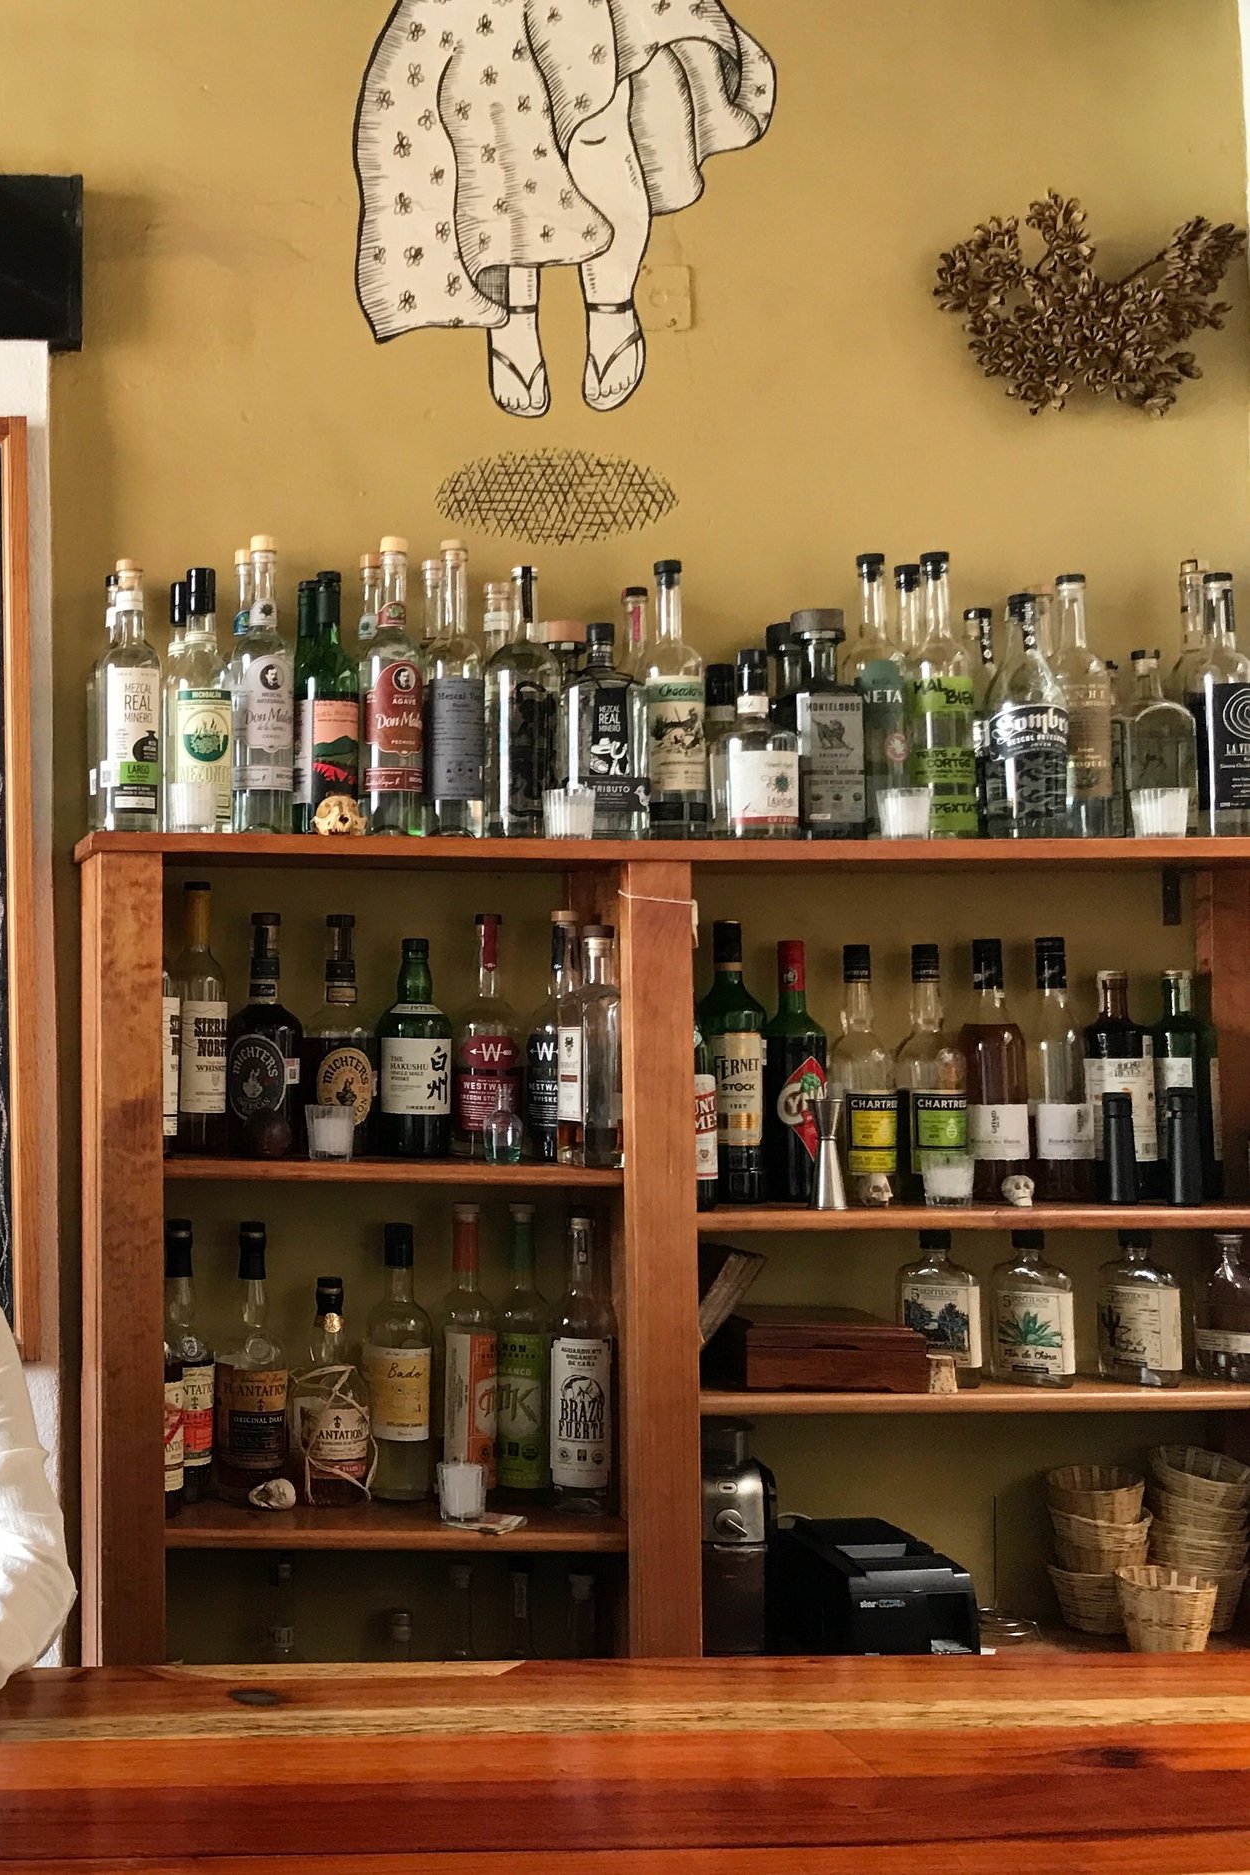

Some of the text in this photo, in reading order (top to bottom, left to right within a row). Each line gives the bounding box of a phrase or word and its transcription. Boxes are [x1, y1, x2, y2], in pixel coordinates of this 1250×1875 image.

[124, 683, 152, 694] MEZCAL
[124, 694, 153, 711] REAL
[392, 697, 417, 706] AGAVE
[862, 689, 903, 704] NETA
[598, 705, 620, 713] MEZCAL
[806, 702, 861, 712] MONTELOBOS
[124, 713, 153, 724] MINERO
[244, 709, 266, 725] Don
[375, 712, 400, 730] Don
[598, 713, 621, 725] REAL
[598, 724, 621, 733] MINERO
[127, 764, 150, 775] LARGO
[592, 785, 631, 793] TRIBUTO
[481, 1042, 501, 1062] W
[536, 1042, 555, 1061] W
[233, 1046, 278, 1078] MICHTER'S
[390, 1062, 429, 1071] HAKUSHU
[323, 1056, 369, 1085] MICHTER'S
[715, 1056, 759, 1081] FERNET
[427, 1045, 448, 1105] 白州
[529, 1083, 558, 1092] WESTWA
[721, 1082, 755, 1091] STOCK
[851, 1098, 898, 1109] CHARTRE
[917, 1098, 967, 1109] CHARTRE
[910, 1287, 959, 1301] 5 SENTIDOS
[1002, 1294, 1051, 1309] 5 SENTIDOS
[223, 1382, 286, 1398] PLANTATION
[560, 1398, 605, 1422] BRAZO
[233, 1415, 283, 1424] ORIGINAL DARK
[316, 1428, 364, 1440] ANTATION
[558, 1419, 605, 1440] FUERTE
